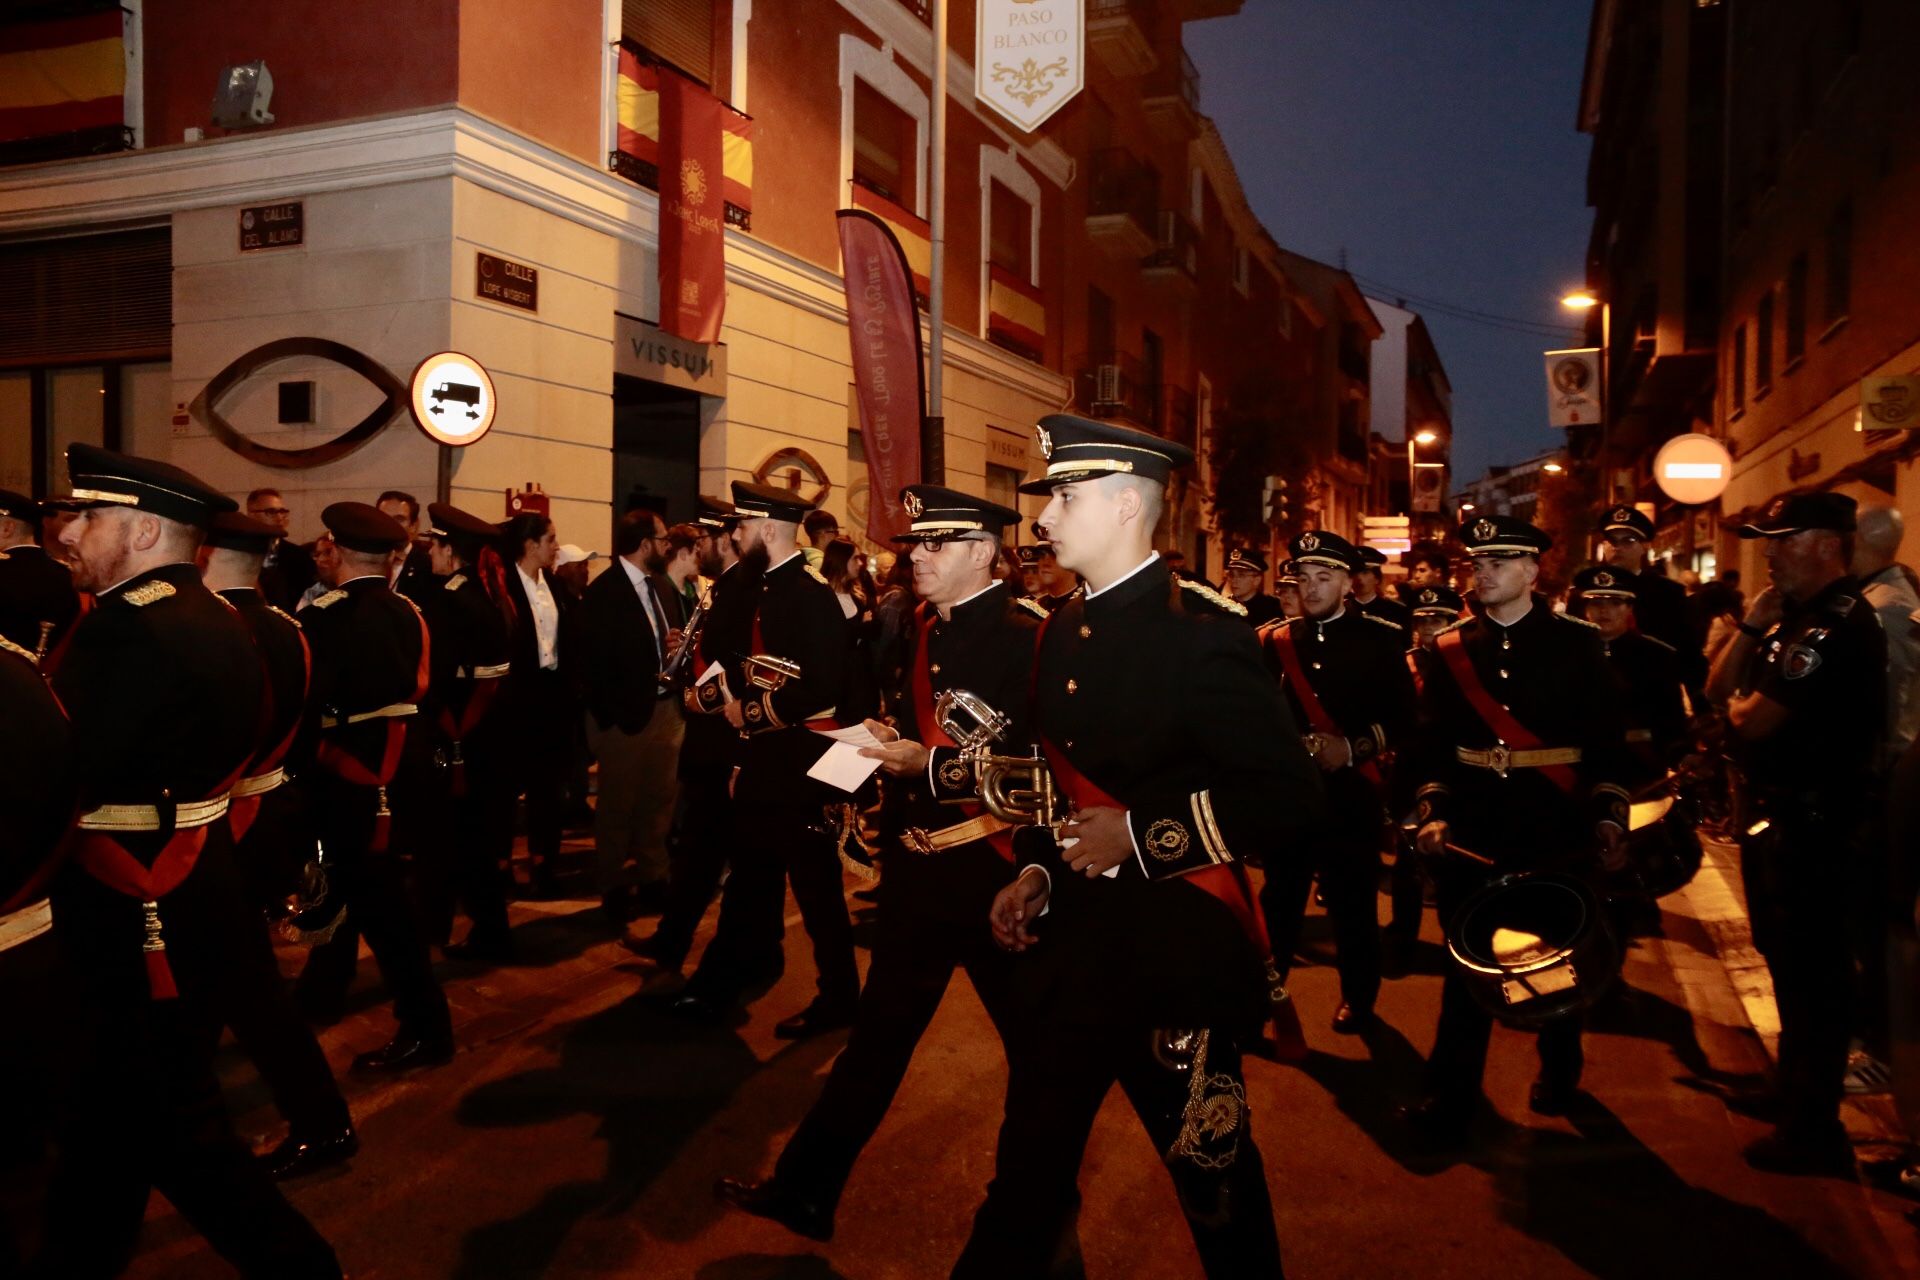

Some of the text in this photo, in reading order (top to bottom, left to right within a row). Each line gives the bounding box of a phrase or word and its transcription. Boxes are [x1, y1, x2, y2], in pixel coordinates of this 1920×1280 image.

[1008, 9, 1053, 27] PASO
[994, 28, 1068, 48] BLANCO
[263, 206, 295, 222] CALLE
[244, 233, 262, 247] DEL
[505, 262, 533, 283] CALLE
[483, 280, 501, 297] LOPE
[630, 336, 713, 379] VISSUM
[991, 440, 1025, 460] VISSUM
